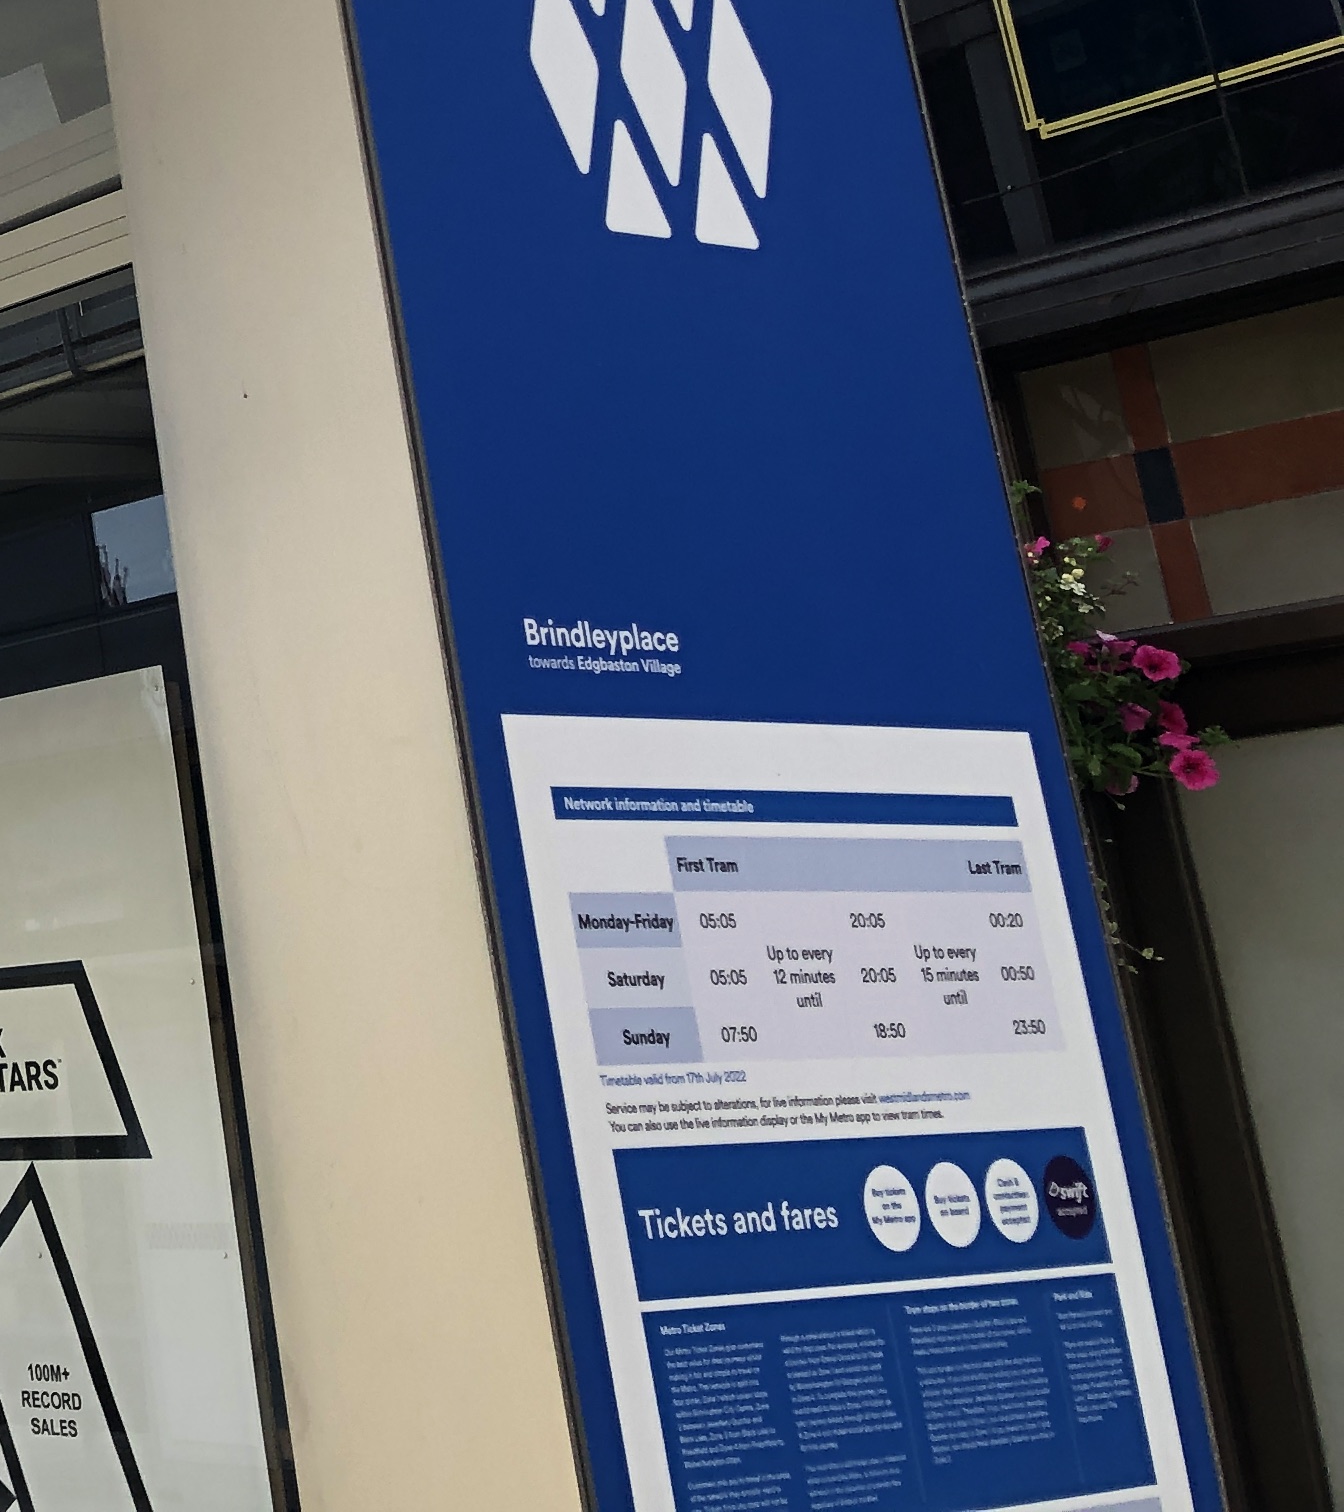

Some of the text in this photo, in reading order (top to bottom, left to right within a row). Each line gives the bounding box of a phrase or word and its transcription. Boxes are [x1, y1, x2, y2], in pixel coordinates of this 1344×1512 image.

[523, 618, 679, 656] Brindleyplace
[528, 655, 681, 677] towards Edgbaston Village
[564, 797, 754, 814] Network information and timetable
[677, 857, 1022, 875] First Tram Last Tram
[578, 913, 1023, 932] Monday-Friday 05:05 20:05 00:20
[767, 946, 833, 964] Up to every
[914, 944, 976, 962] Up to every
[607, 970, 747, 989] Saturday 05:05
[773, 969, 835, 985] 12 minutes
[861, 967, 896, 983] 20:05
[921, 967, 979, 983] 15 minutes
[1000, 965, 1035, 982] 00:50
[797, 992, 823, 1008] until
[943, 989, 968, 1005] until
[623, 1019, 1046, 1048] Sunday 07:50 18:50 23:50
[606, 1102, 637, 1114] Service
[638, 1201, 839, 1239] Tickets and fares
[27, 1363, 70, 1383] 100M+
[21, 1391, 82, 1411] RECORD
[30, 1417, 78, 1438] SALES
